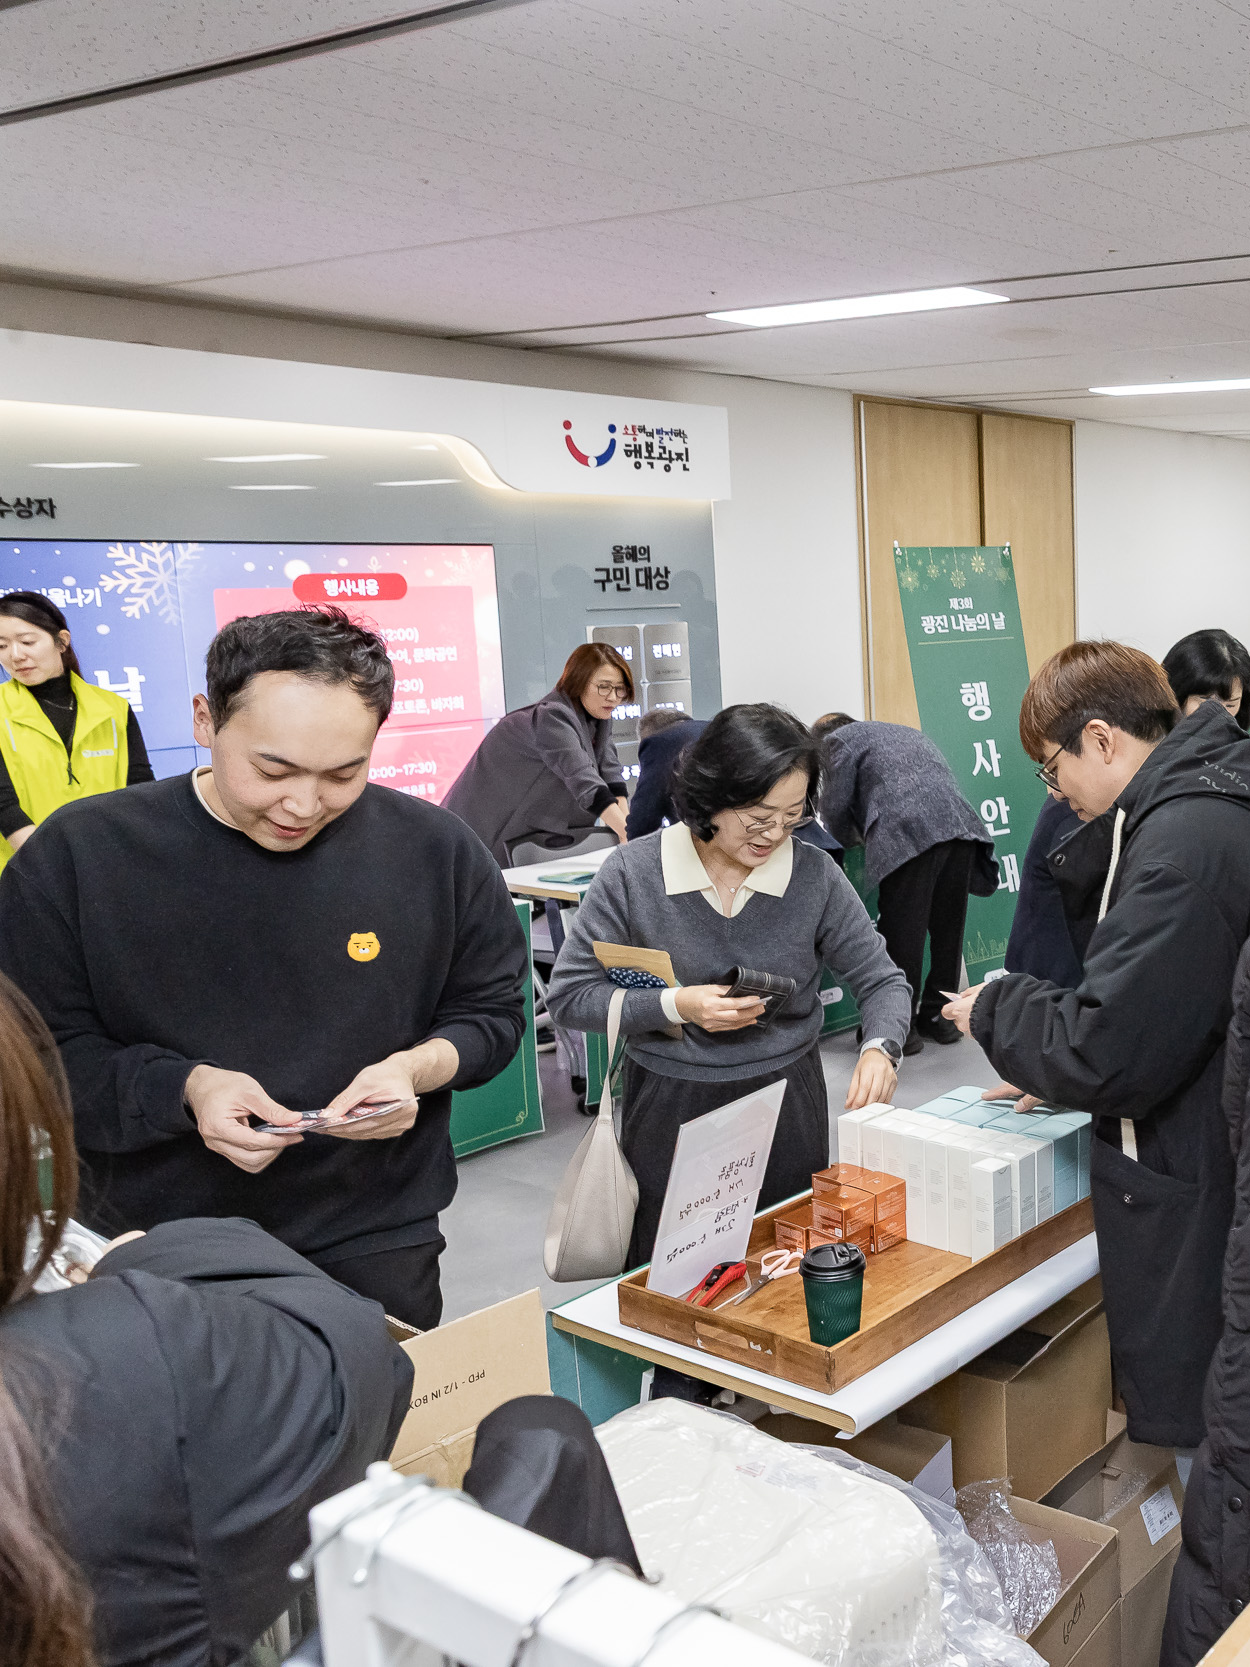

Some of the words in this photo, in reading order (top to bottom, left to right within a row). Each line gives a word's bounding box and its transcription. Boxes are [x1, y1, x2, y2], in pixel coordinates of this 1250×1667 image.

[622, 424, 655, 442] 소통하며
[655, 427, 689, 444] 발전하는
[623, 441, 690, 473] 행복광진
[612, 545, 651, 563] 올해의
[594, 566, 632, 592] 구민
[635, 566, 671, 591] 대상
[323, 579, 380, 597] 행사내용
[949, 597, 974, 610] 제3회
[921, 615, 949, 634] 광진
[950, 612, 990, 632] 나눔의
[991, 612, 1006, 630] 날
[413, 646, 458, 663] 문화공연
[431, 695, 465, 712] 바자회
[468, 1369, 486, 1384] PFD
[431, 1388, 441, 1401] IN
[444, 1381, 459, 1395] 1/2
[409, 1394, 428, 1410] BOX
